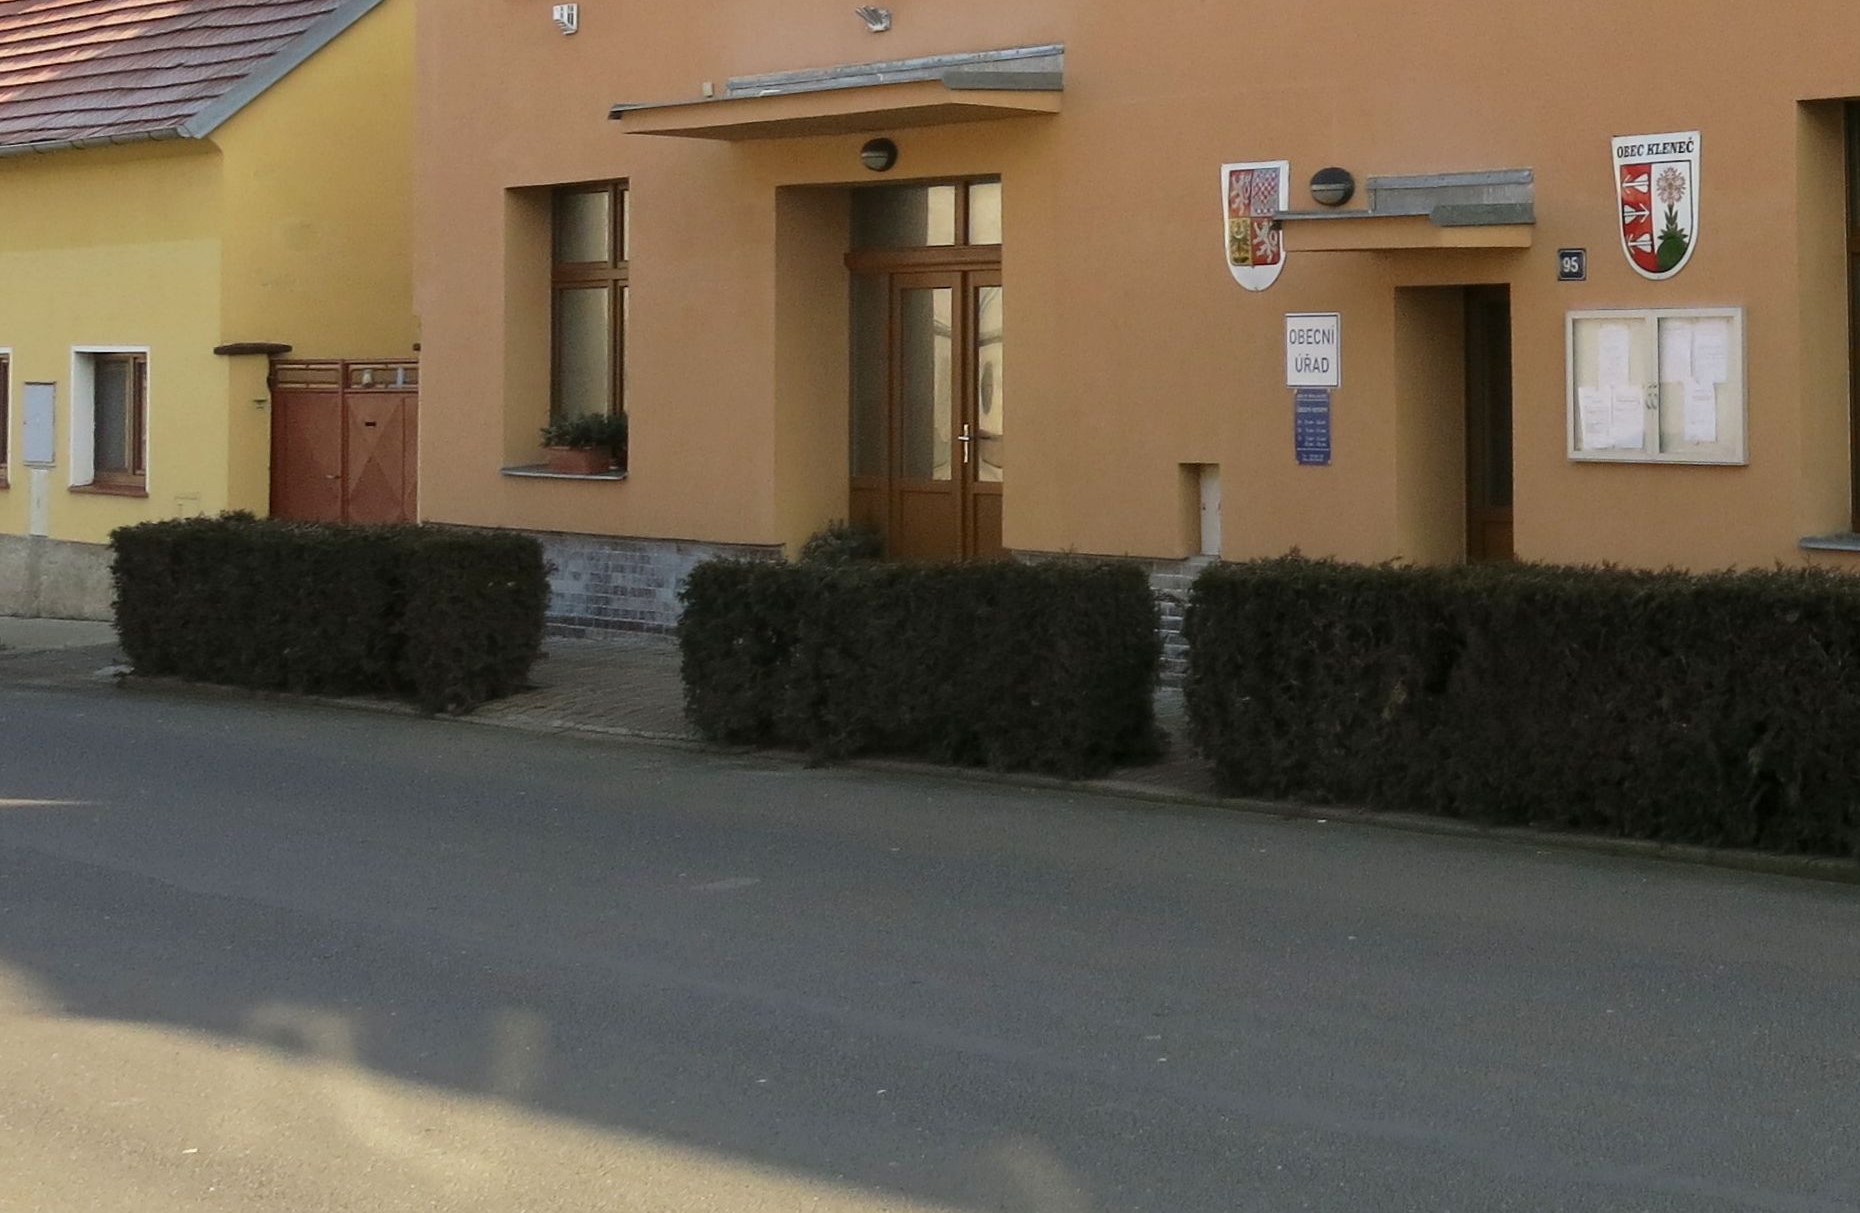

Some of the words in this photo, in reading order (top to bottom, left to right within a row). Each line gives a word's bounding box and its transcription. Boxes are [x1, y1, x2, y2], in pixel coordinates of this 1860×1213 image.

[1616, 144, 1645, 158] OBEC
[1646, 136, 1695, 156] KLENEČ
[1563, 256, 1579, 273] 95
[1289, 324, 1335, 345] OBECNÍ
[1295, 353, 1330, 373] ÚŘAD
